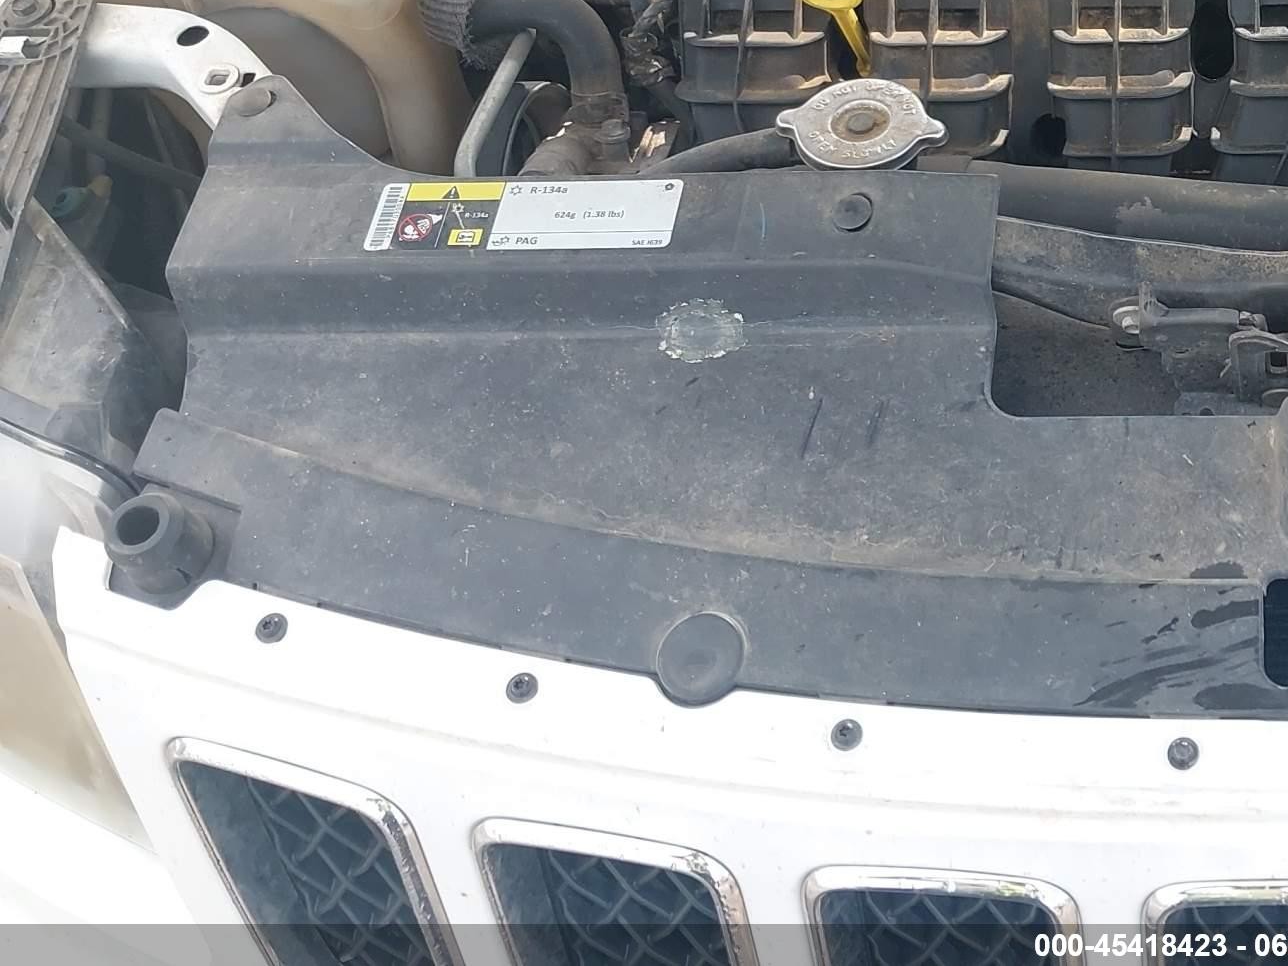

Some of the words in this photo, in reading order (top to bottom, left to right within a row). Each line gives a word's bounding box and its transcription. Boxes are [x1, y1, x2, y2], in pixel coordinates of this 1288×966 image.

[832, 85, 858, 98] NOT
[530, 185, 569, 194] R-134a
[554, 211, 577, 220] 624g
[583, 210, 606, 220] (1.38
[608, 210, 625, 219] lbs)
[515, 236, 539, 245] PAG
